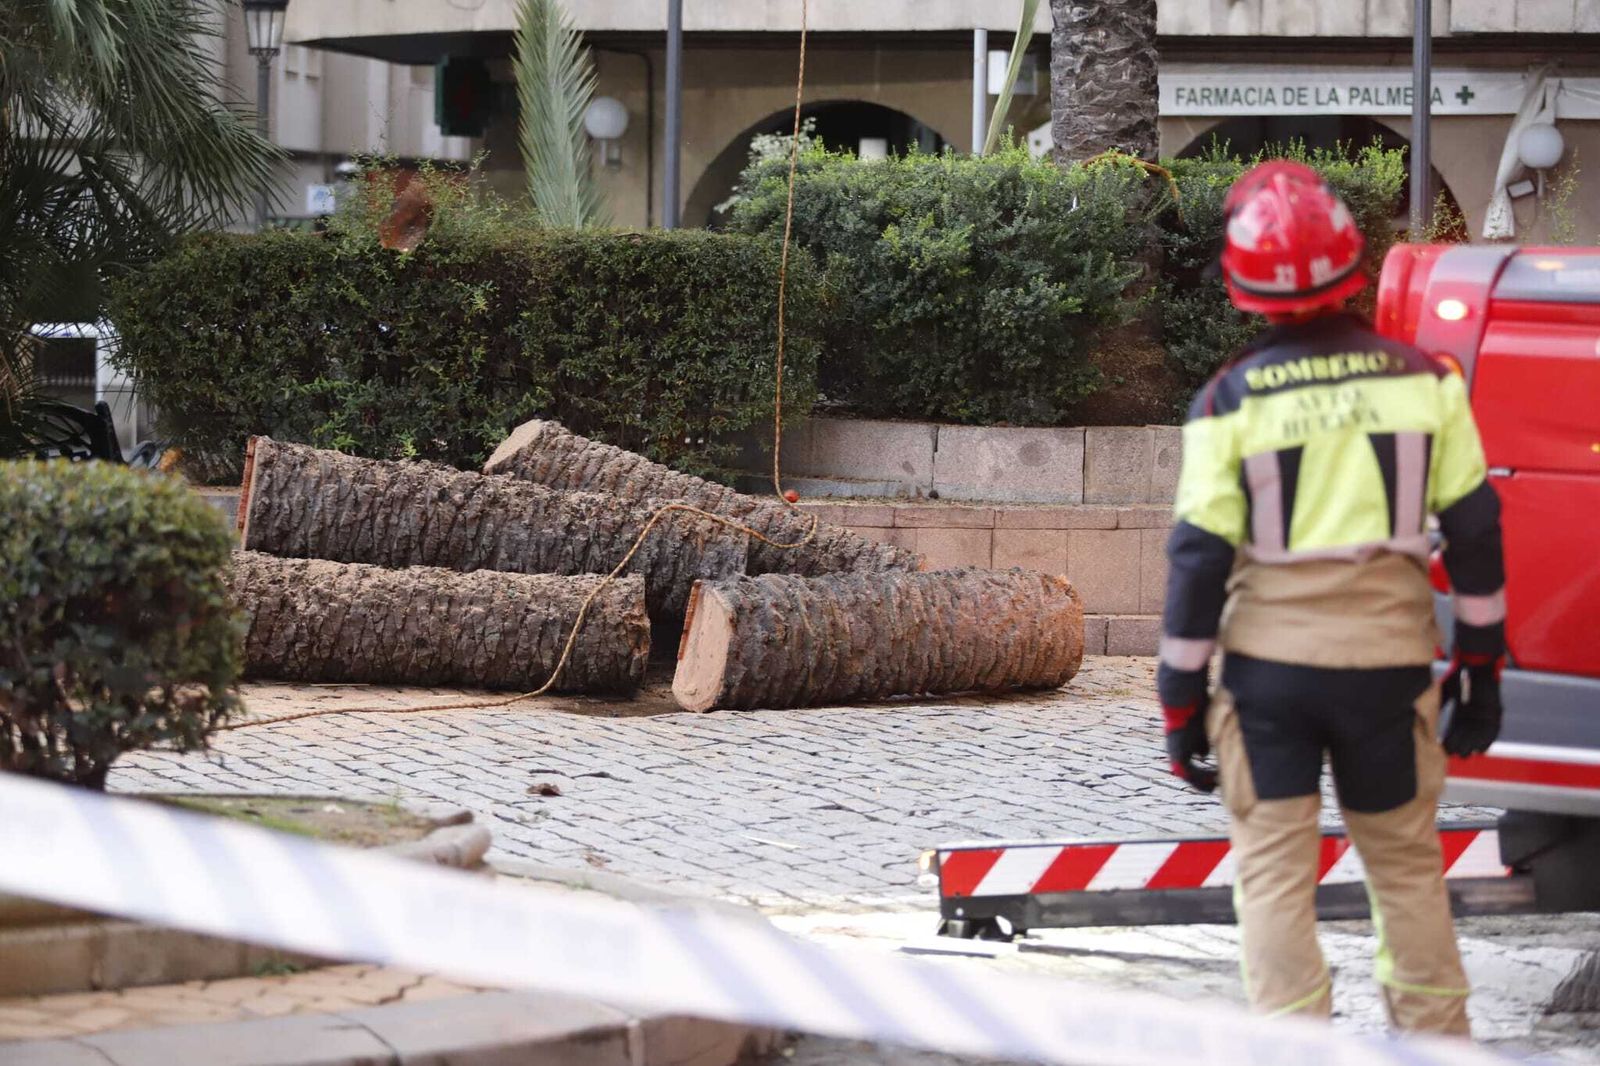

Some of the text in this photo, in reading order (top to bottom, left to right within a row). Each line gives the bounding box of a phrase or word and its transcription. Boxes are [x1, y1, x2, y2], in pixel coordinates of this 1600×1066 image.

[1175, 86, 1444, 106] FARMACIA DE LA PALMEA
